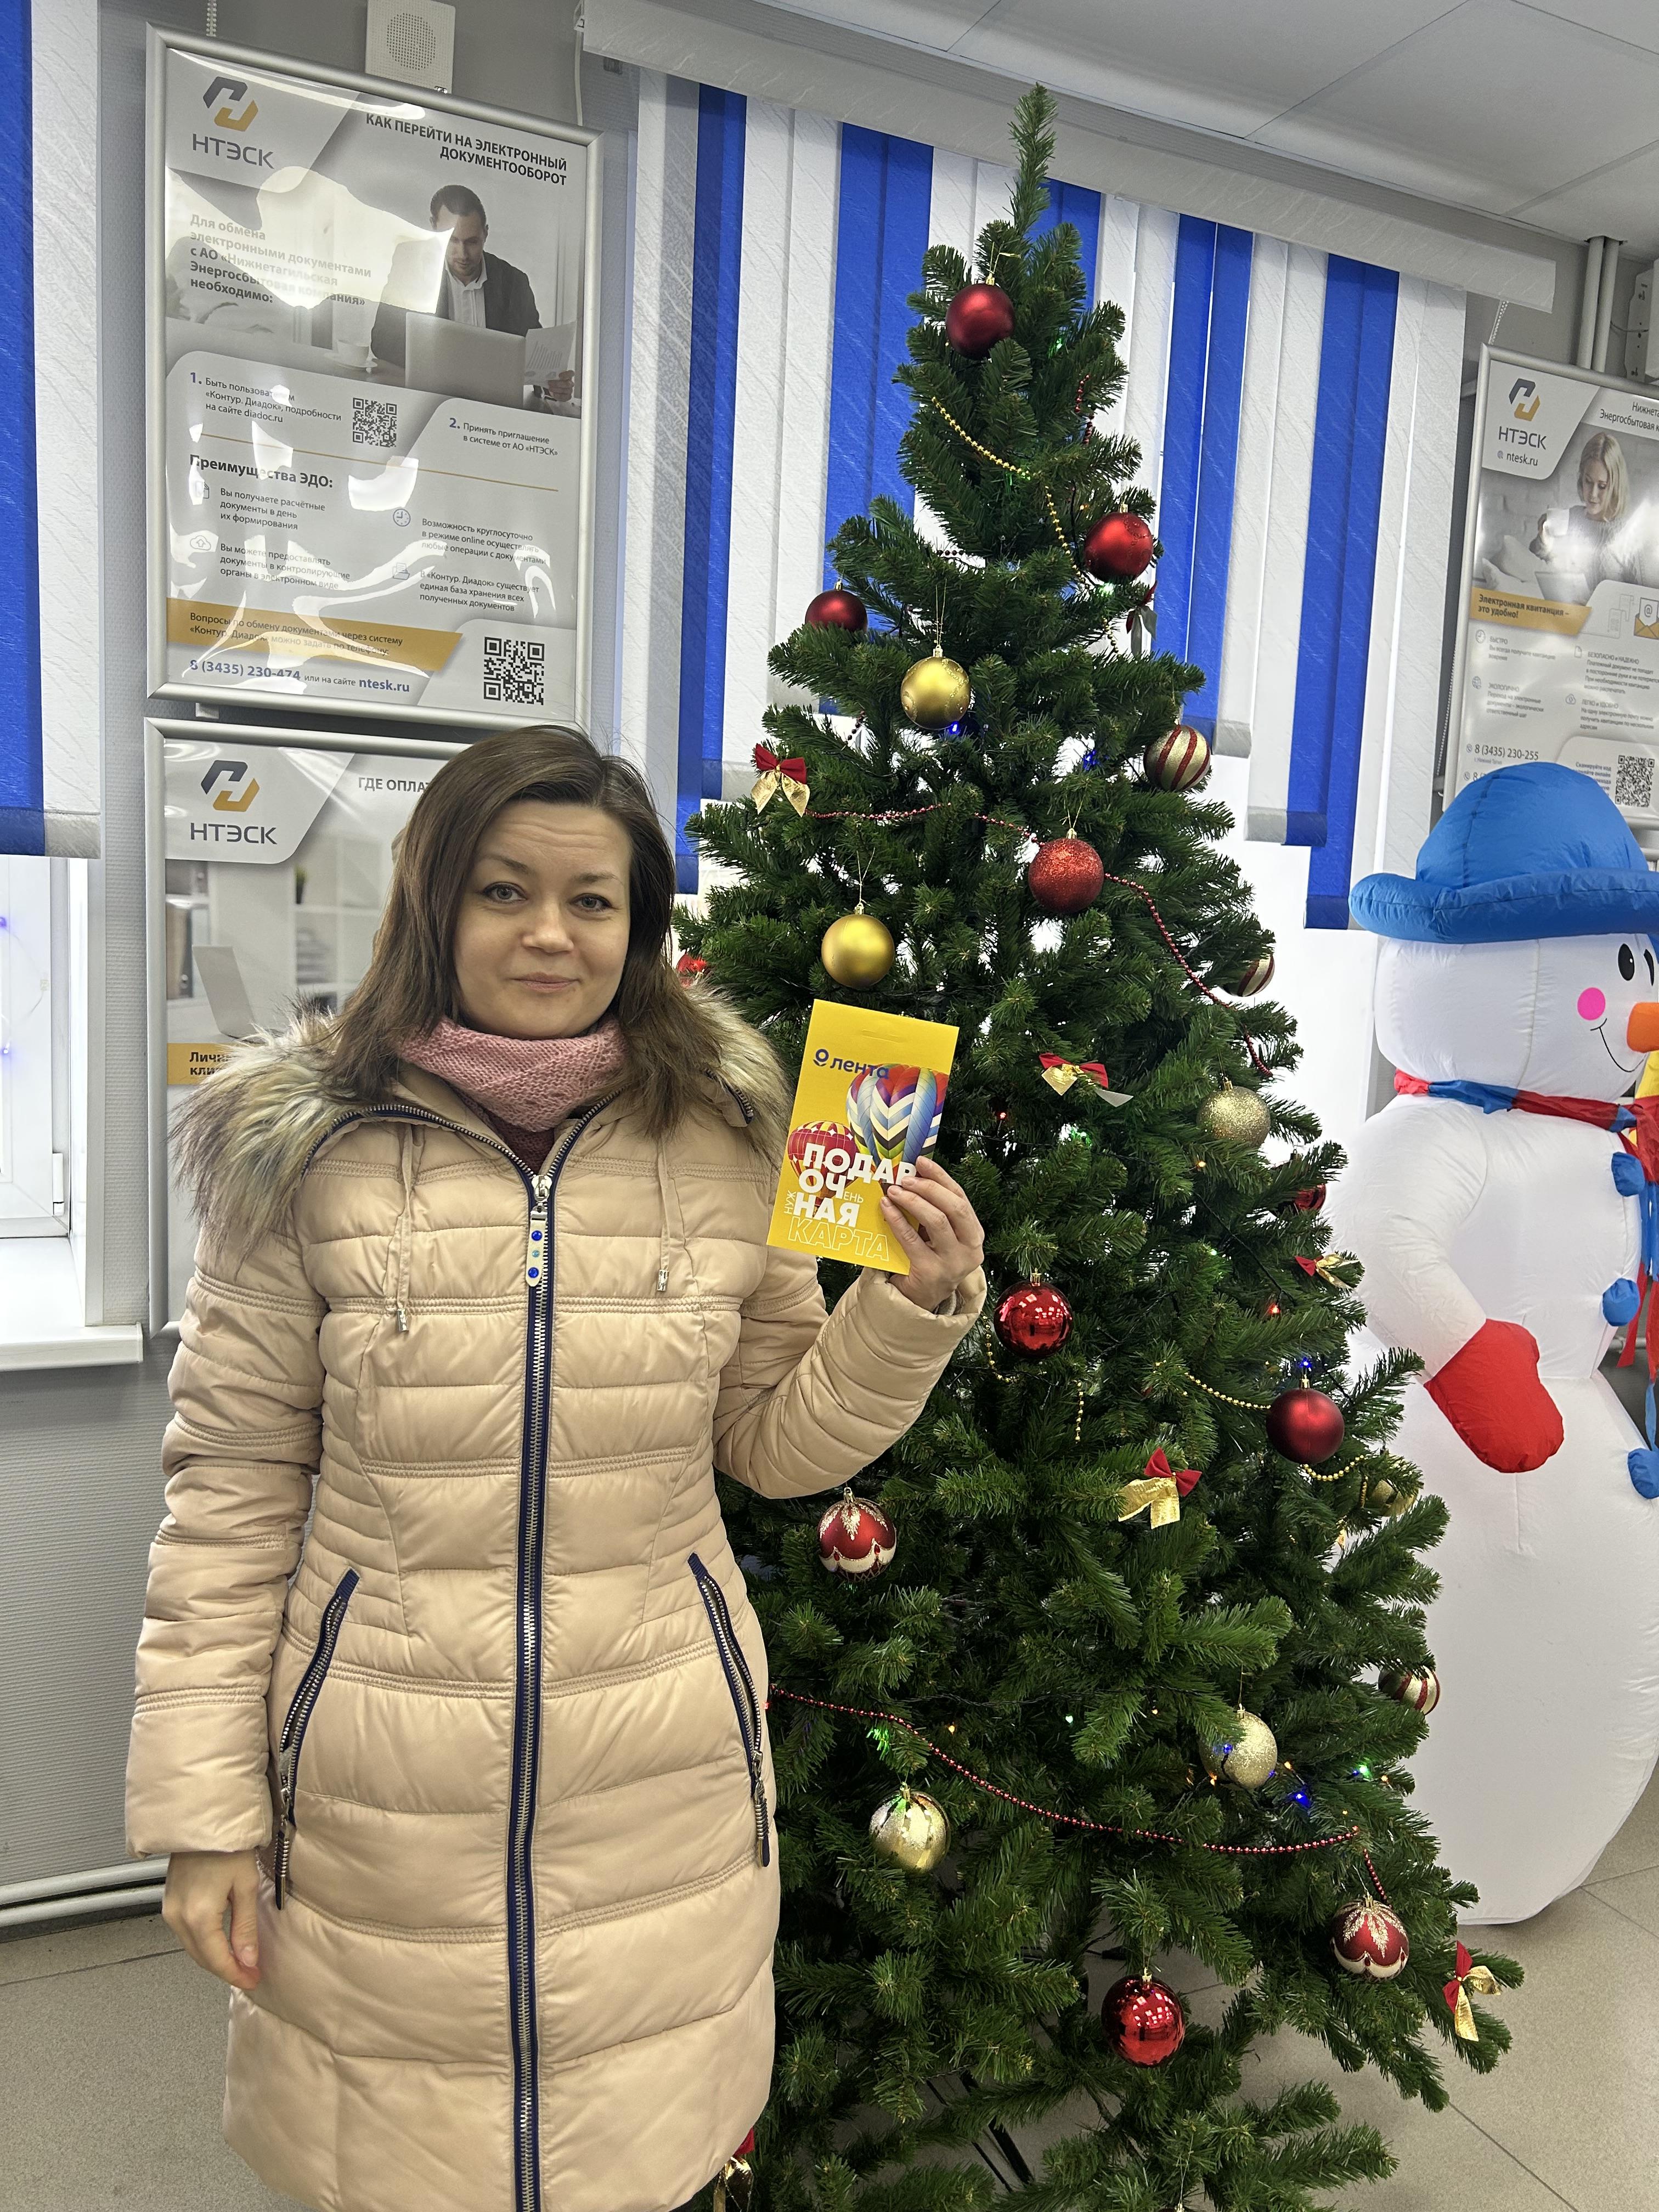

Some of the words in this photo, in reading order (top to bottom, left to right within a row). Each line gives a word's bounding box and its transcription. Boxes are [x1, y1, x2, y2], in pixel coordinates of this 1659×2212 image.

[193, 133, 274, 169] НТЭСК
[366, 113, 392, 129] КАК
[394, 120, 452, 143] ПЕРЕЙТИ
[455, 134, 472, 148] НА
[476, 138, 567, 171] ЭЛЕКТРОННЫЙ
[440, 146, 567, 185] ДОКУМЕНТООБОРОТ
[190, 214, 215, 229] Для
[219, 222, 266, 240] обмена
[190, 232, 285, 260] электронными
[288, 253, 371, 277] документами
[200, 247, 218, 260] АО
[190, 279, 273, 303] необходимо:
[190, 373, 202, 384] 1.
[206, 377, 227, 389] Быть
[229, 383, 295, 401] пользовам
[206, 391, 244, 404] «Контур.
[245, 397, 283, 411] Диадок»,
[285, 406, 341, 421] подробности
[218, 404, 242, 415] сайте
[244, 409, 283, 422] diadoc.ru
[449, 417, 460, 429] 2.
[464, 423, 496, 435] Принять
[498, 431, 549, 444] приглашение
[1599, 409, 1655, 430] Энергосбытовая
[470, 437, 500, 447] системе
[526, 445, 558, 456] «НТЭСК»
[1498, 426, 1547, 450] НТЭСК
[1506, 452, 1538, 466] ntesk.ru
[190, 454, 296, 482] Преимущества
[300, 473, 333, 488] ЭДО:
[220, 501, 268, 514] документы
[276, 510, 297, 519] день
[221, 488, 233, 496] Вы
[235, 492, 279, 504] получаете
[281, 498, 325, 511] расчётные
[233, 514, 298, 530] формирования
[422, 518, 475, 533] Возможность
[477, 527, 533, 541] круглосуточно
[428, 532, 459, 541] режиме
[461, 535, 485, 545] online
[220, 556, 268, 568] документы
[221, 543, 233, 552] Вы
[234, 548, 267, 557] можете
[268, 551, 331, 566] предоставлять
[450, 546, 488, 556] операции
[221, 568, 252, 578] органы
[261, 573, 317, 586] электронном
[319, 582, 338, 590] виде
[462, 576, 494, 587] Диадок»
[496, 582, 539, 594] существует
[420, 583, 448, 591] единая
[450, 585, 467, 594] база
[469, 589, 506, 599] хранения
[420, 594, 467, 606] полученных
[469, 600, 515, 612] документов
[1479, 594, 1525, 609] Электронная
[1526, 604, 1564, 616] квитанция
[1491, 608, 1519, 618] удобно!
[190, 613, 230, 625] Вопросы
[246, 620, 280, 631] обмену
[342, 632, 367, 641] через
[369, 634, 403, 646] систему
[272, 636, 301, 645] можно
[190, 659, 198, 670] 8
[202, 660, 244, 676] (3435)
[247, 665, 301, 680] 230-474
[334, 677, 356, 686] сайте
[359, 678, 410, 692] ntesk.ru
[1475, 744, 1480, 754] 8
[1482, 744, 1505, 758] (3435)
[1508, 748, 1539, 761] 230-255
[358, 777, 383, 791] ГДЕ
[190, 822, 277, 845] НТЭСК
[189, 1051, 229, 1062] Личн
[830, 1058, 889, 1080] лента
[803, 1142, 917, 1186] ПОДАР
[799, 1169, 847, 1200] ОЧ
[844, 1191, 864, 1203] ЕНЬ
[793, 1192, 860, 1227] НАЯ
[788, 1216, 889, 1262] КАРТА
